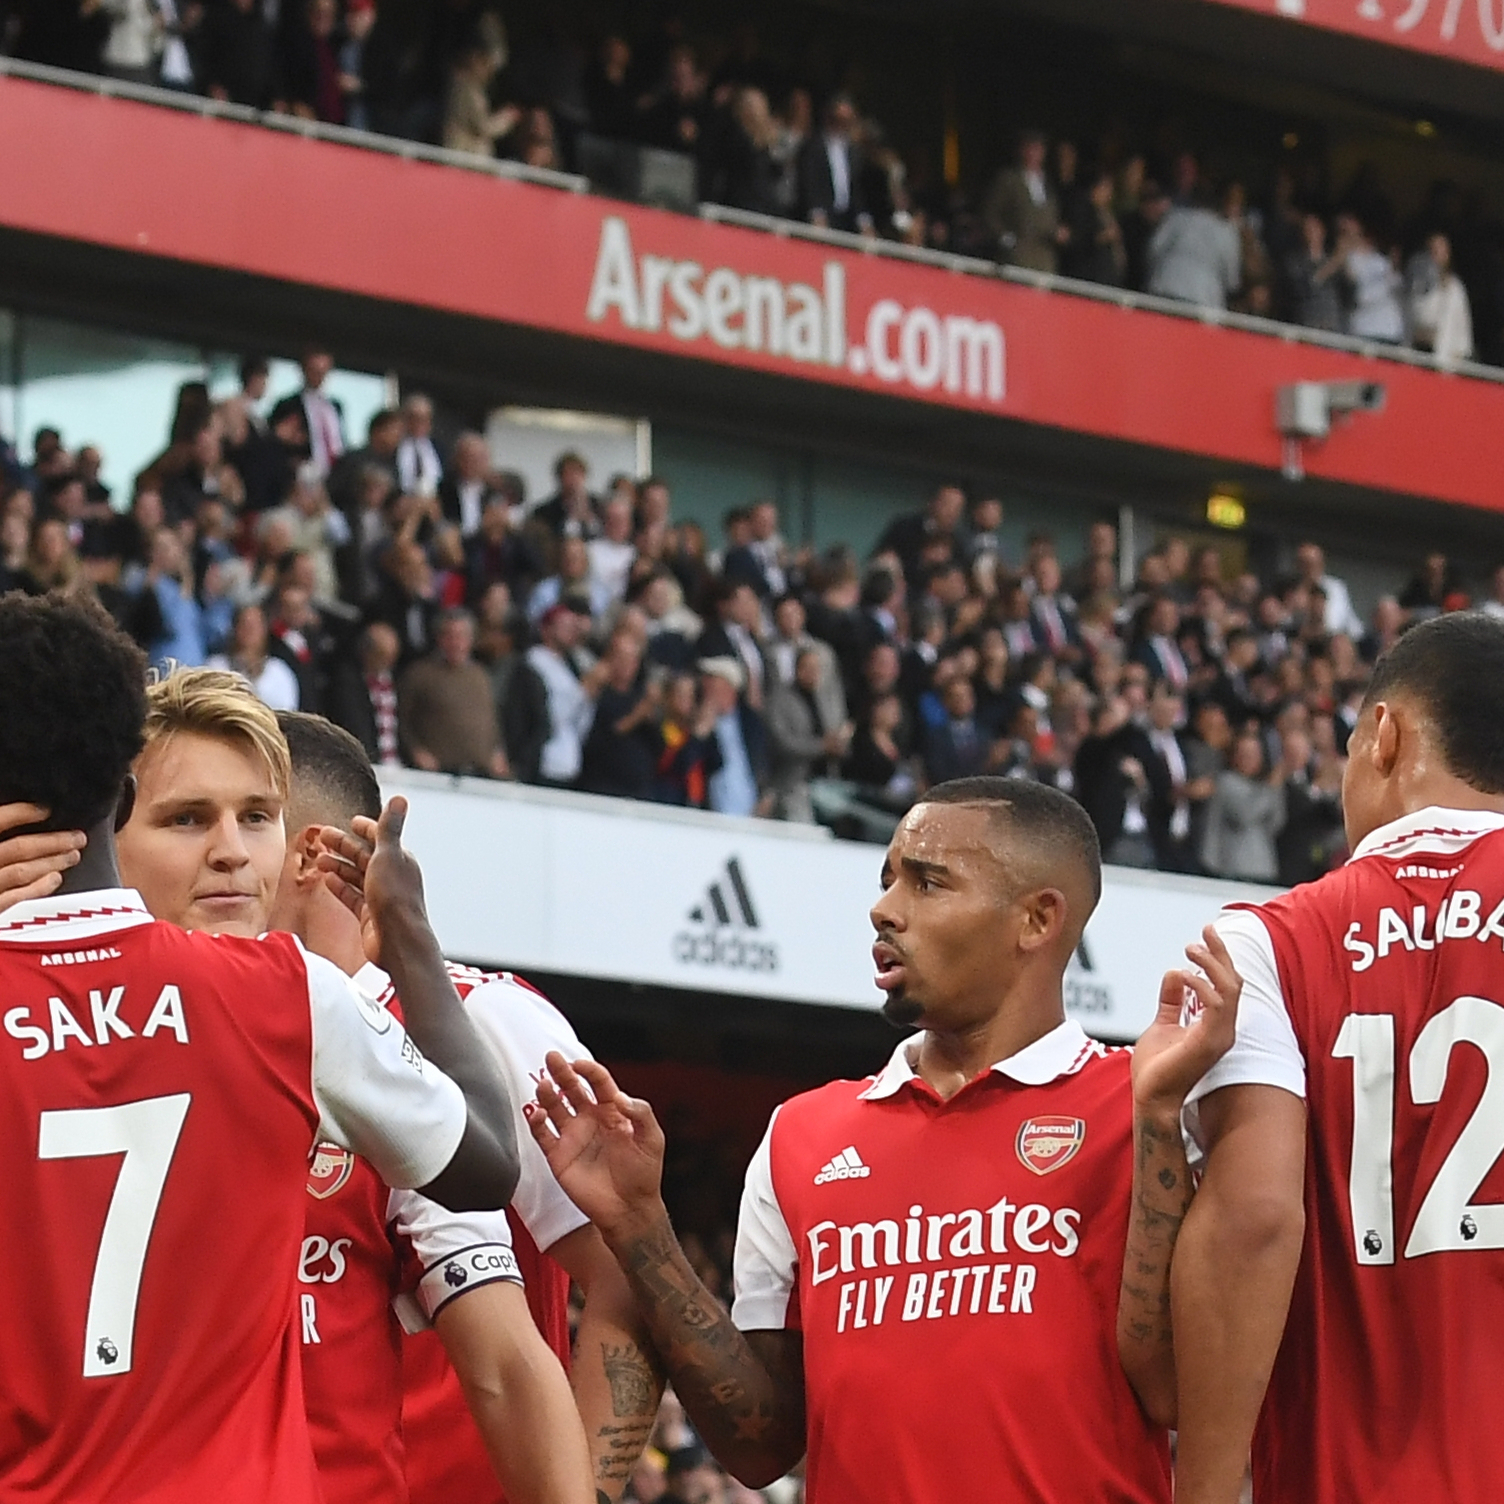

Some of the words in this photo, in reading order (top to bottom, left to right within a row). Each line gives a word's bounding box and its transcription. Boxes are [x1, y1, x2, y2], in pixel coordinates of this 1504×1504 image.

[585, 215, 1007, 404] Arsenal.com
[1394, 863, 1465, 880] ARSENA
[40, 946, 123, 967] ARSENAL
[672, 930, 781, 973] adidas
[3, 983, 192, 1062] SAKA
[1026, 1124, 1075, 1135] Arsenal
[813, 1159, 871, 1186] adidas
[38, 1092, 192, 1378] 7
[806, 1195, 1082, 1287] Emirates
[471, 1253, 517, 1273] Capt
[836, 1275, 895, 1334] FLY
[901, 1263, 1037, 1323] BETTER
